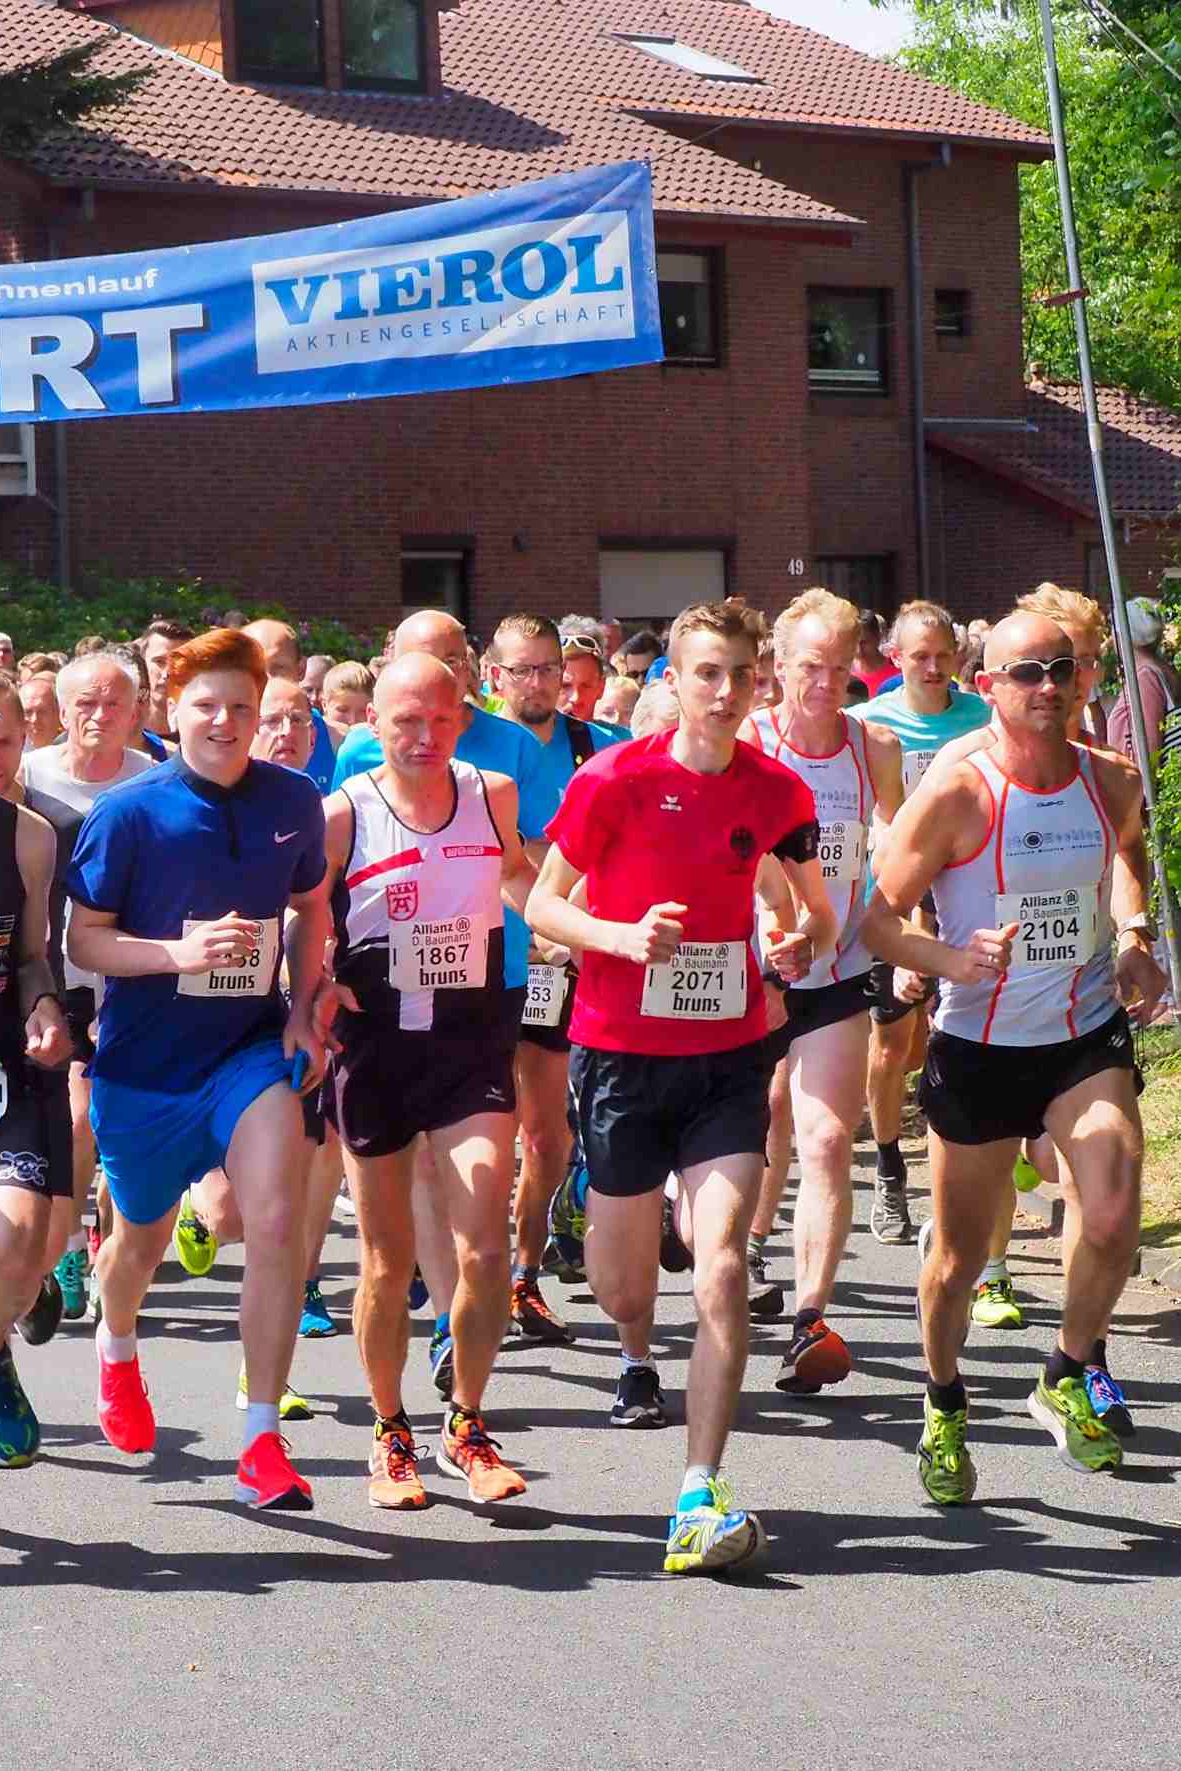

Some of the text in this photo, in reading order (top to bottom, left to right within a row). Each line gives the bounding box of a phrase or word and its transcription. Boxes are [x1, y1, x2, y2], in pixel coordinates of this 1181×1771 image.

[265, 235, 624, 326] VIEROL
[287, 304, 629, 353] AKTIENGESELLSCHAFT
[788, 559, 804, 576] 49
[820, 844, 843, 861] 08
[388, 883, 416, 894] MTV
[1020, 895, 1062, 909] Allianz
[412, 923, 454, 935] Allianz
[1023, 916, 1080, 941] 2104
[426, 932, 472, 945] Baumann
[415, 943, 470, 966] 1867
[675, 944, 714, 957] Allianz
[1026, 943, 1076, 961] bruns
[685, 958, 728, 969] Baumann
[209, 970, 256, 989] bruns
[419, 968, 467, 986] bruns
[671, 970, 724, 990] 2071
[530, 986, 551, 1002] 53
[673, 992, 722, 1012] bruns
[524, 1006, 547, 1020] uns
